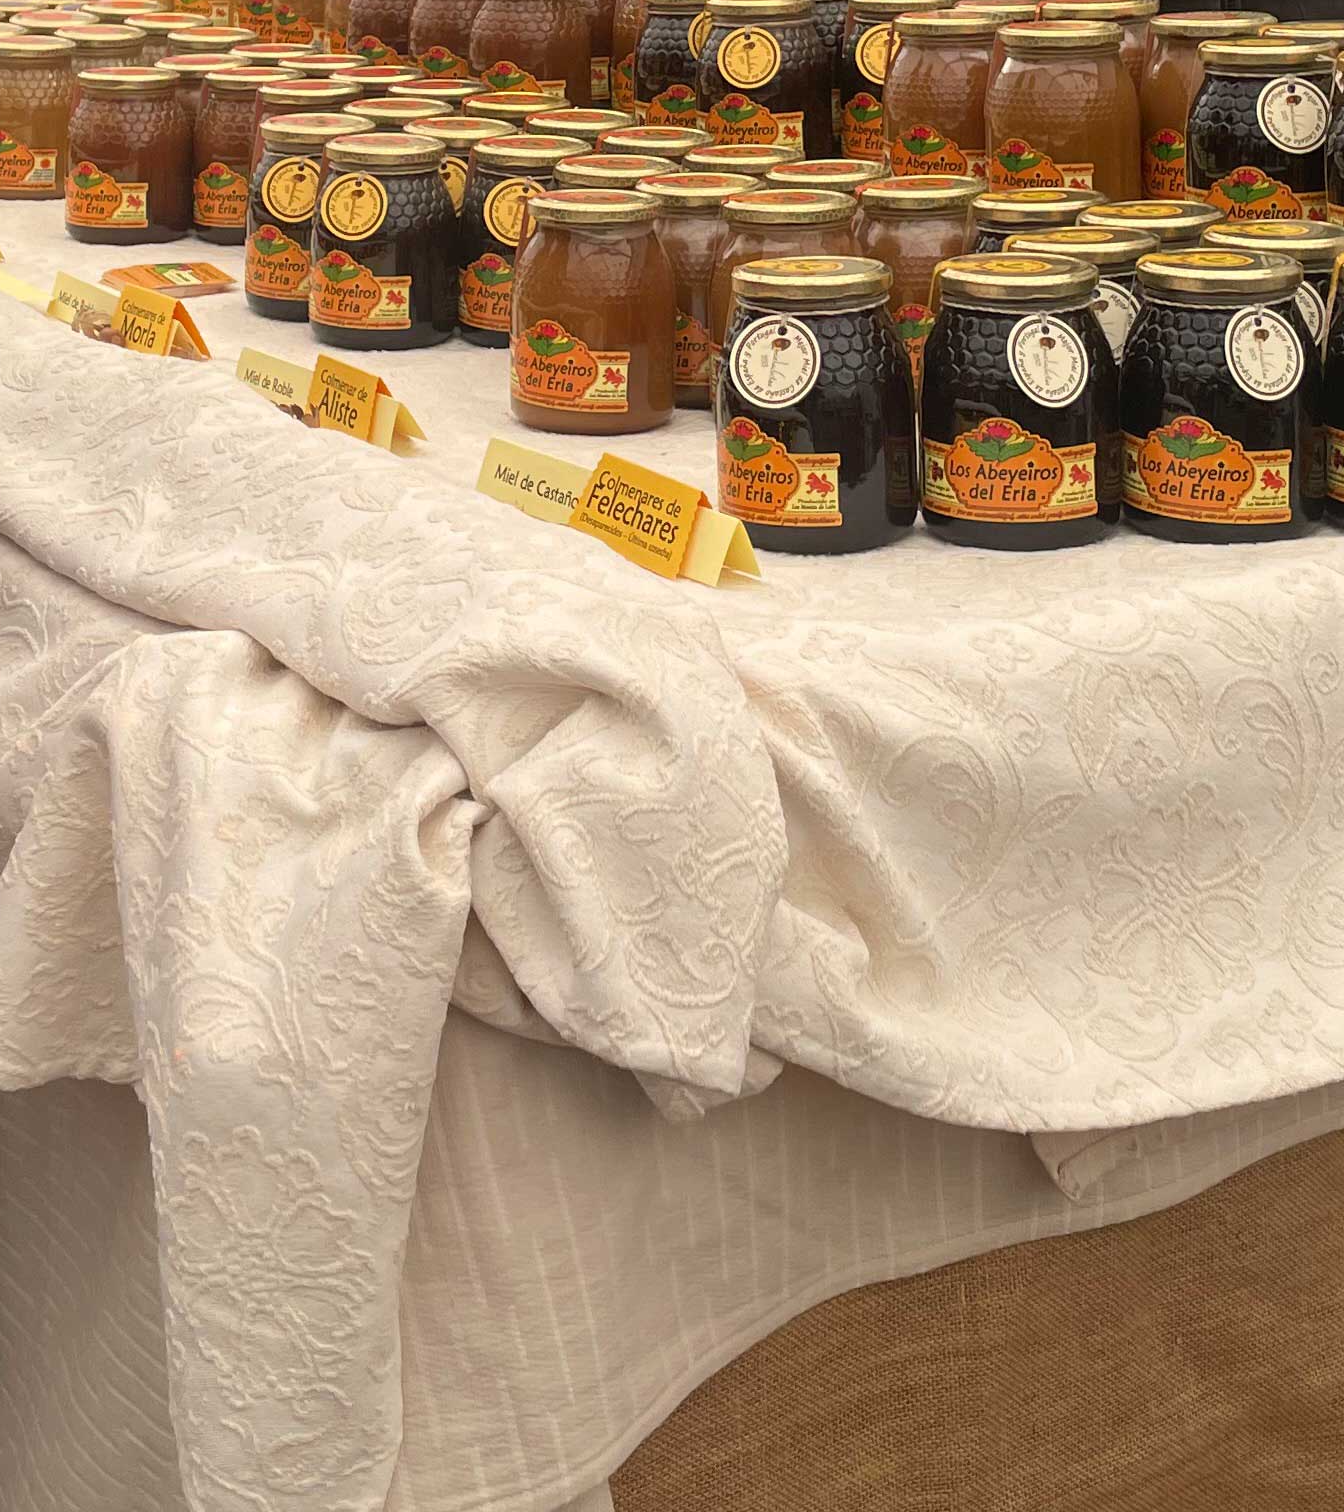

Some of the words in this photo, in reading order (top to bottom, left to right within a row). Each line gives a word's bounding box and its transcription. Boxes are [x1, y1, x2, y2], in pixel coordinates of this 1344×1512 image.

[722, 121, 774, 137] Abeyeiros
[906, 157, 962, 173] Abeyeiros
[1003, 173, 1060, 188] Abeyeiros
[74, 189, 119, 203] Abeyeiros
[206, 190, 247, 203] Abeyeiro
[1227, 203, 1297, 220] Abeyeiros
[256, 257, 306, 276] Abeyeiros
[269, 271, 290, 285] Eria
[324, 284, 377, 304] Abeyeiros
[320, 297, 335, 311] del
[338, 298, 361, 313] Eria
[472, 299, 487, 312] del
[492, 303, 509, 317] Eri
[157, 312, 166, 325] de
[121, 314, 156, 348] Morla
[530, 360, 594, 380] Abeyeiros
[320, 369, 357, 397] Colmenar
[357, 386, 368, 402] de
[525, 373, 542, 387] del
[548, 376, 574, 392] Eria
[319, 387, 358, 429] Aliste
[729, 464, 795, 485] Abeyeiros
[950, 460, 970, 477] Los
[975, 461, 1058, 484] Abeyeiros
[1142, 457, 1161, 473] Los
[1165, 462, 1249, 483] Abeyeiros
[494, 463, 519, 488] Miel
[519, 472, 534, 492] de
[536, 479, 579, 509] Castaño
[599, 470, 665, 511] Colmenares
[665, 498, 682, 518] de
[726, 482, 741, 497] del
[745, 485, 773, 503] Eria
[969, 483, 993, 500] del
[1002, 485, 1036, 501] Eria
[1159, 479, 1182, 496] del
[1191, 483, 1225, 501] Eria
[586, 483, 679, 544] Felechares
